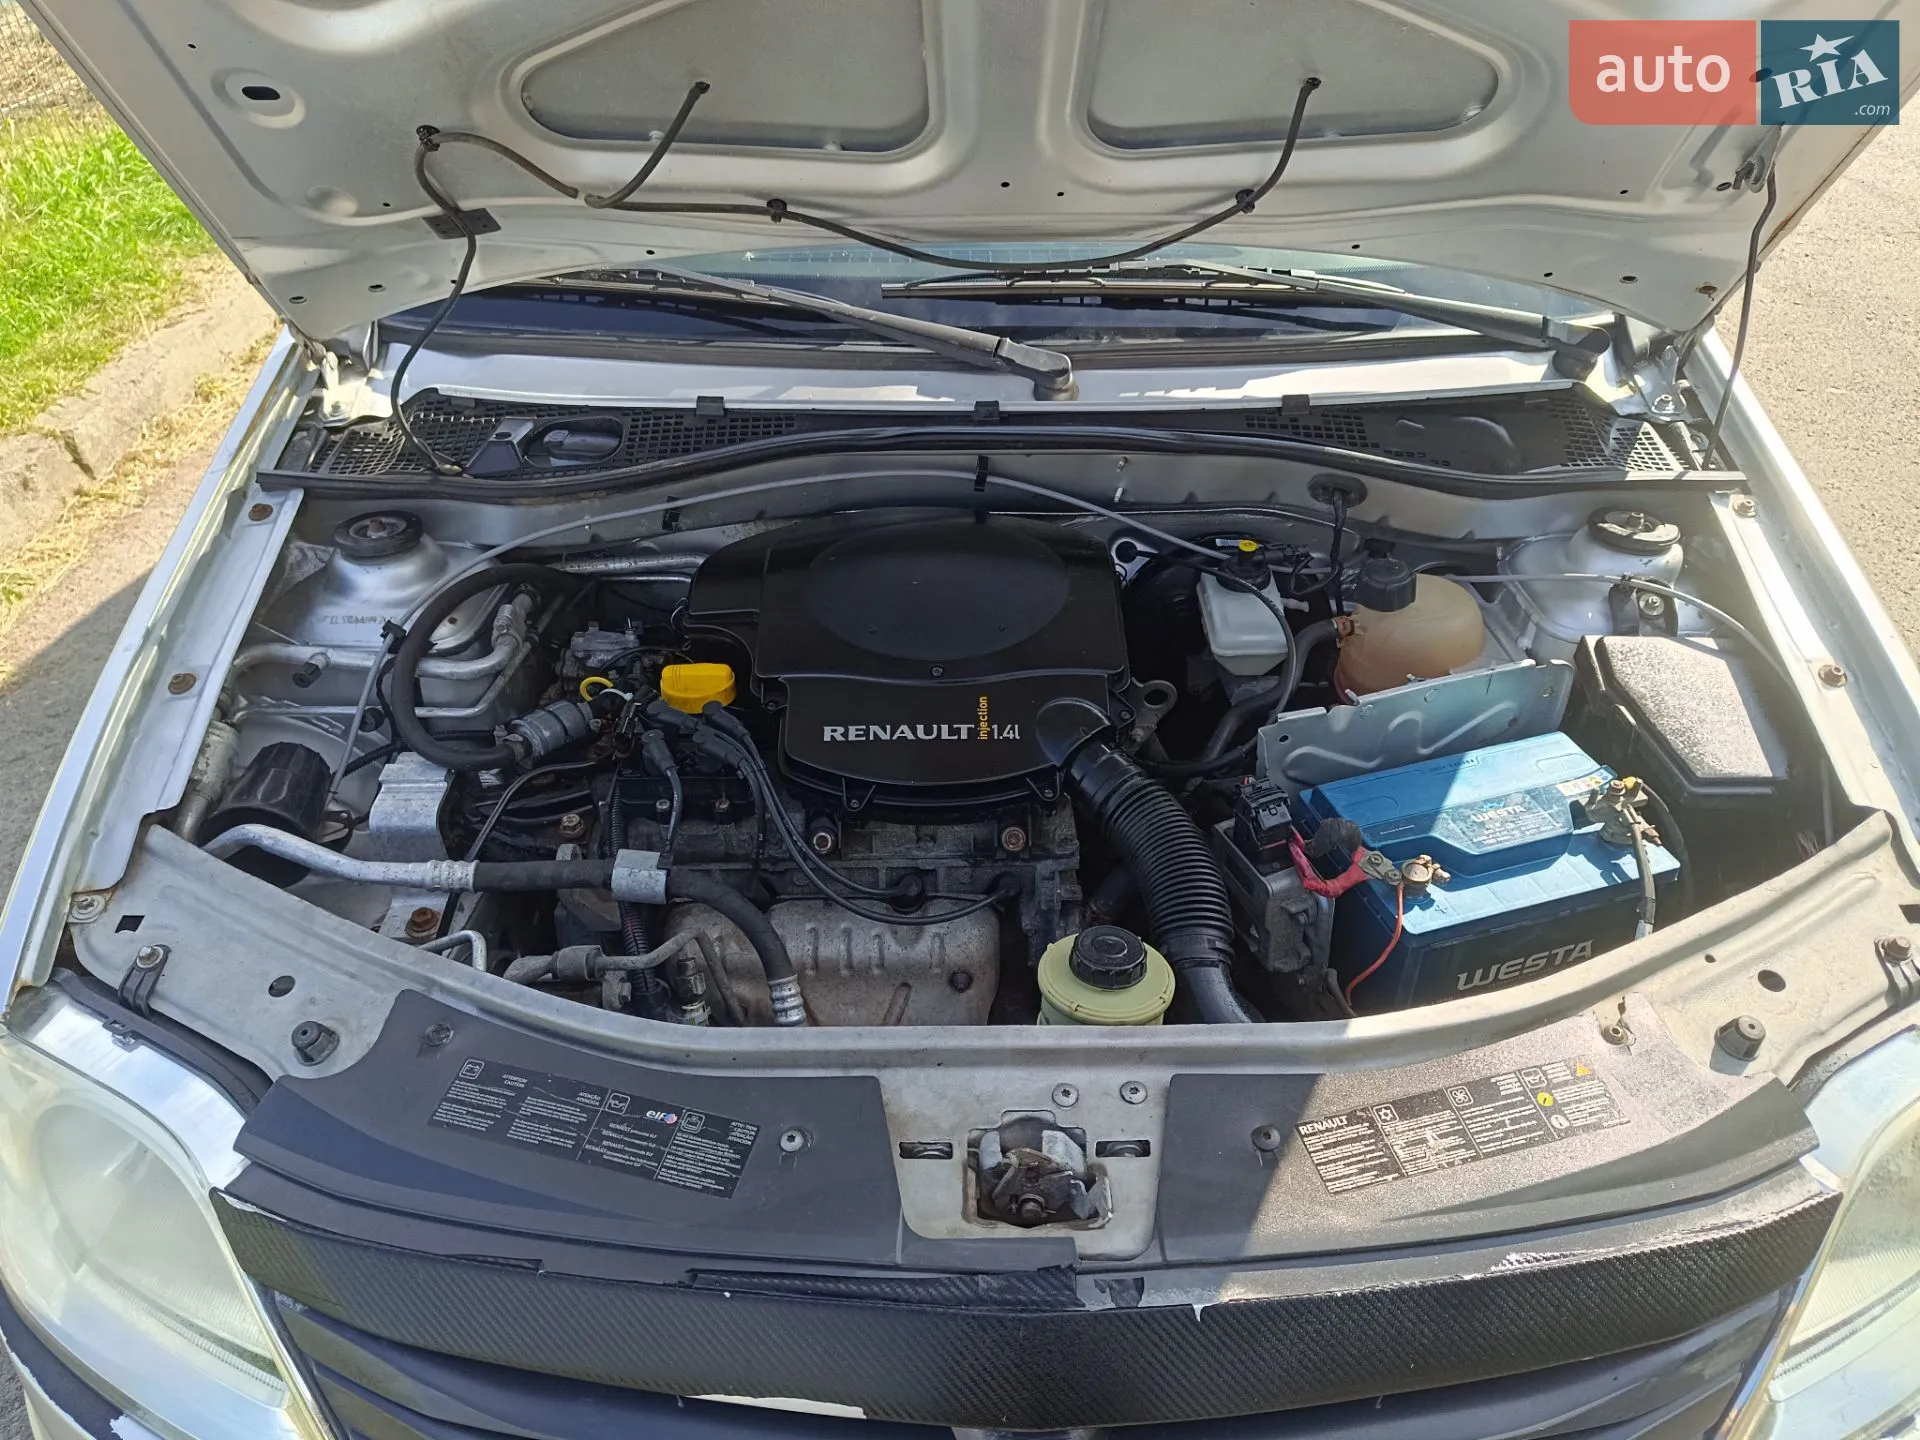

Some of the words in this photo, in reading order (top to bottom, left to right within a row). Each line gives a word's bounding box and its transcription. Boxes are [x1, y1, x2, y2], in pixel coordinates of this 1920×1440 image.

[977, 695, 991, 740] injection
[823, 724, 975, 742] RENAULT
[1470, 804, 1527, 823] WESTA
[1457, 938, 1595, 991] WESTA
[1298, 1115, 1348, 1136] RENAULT
